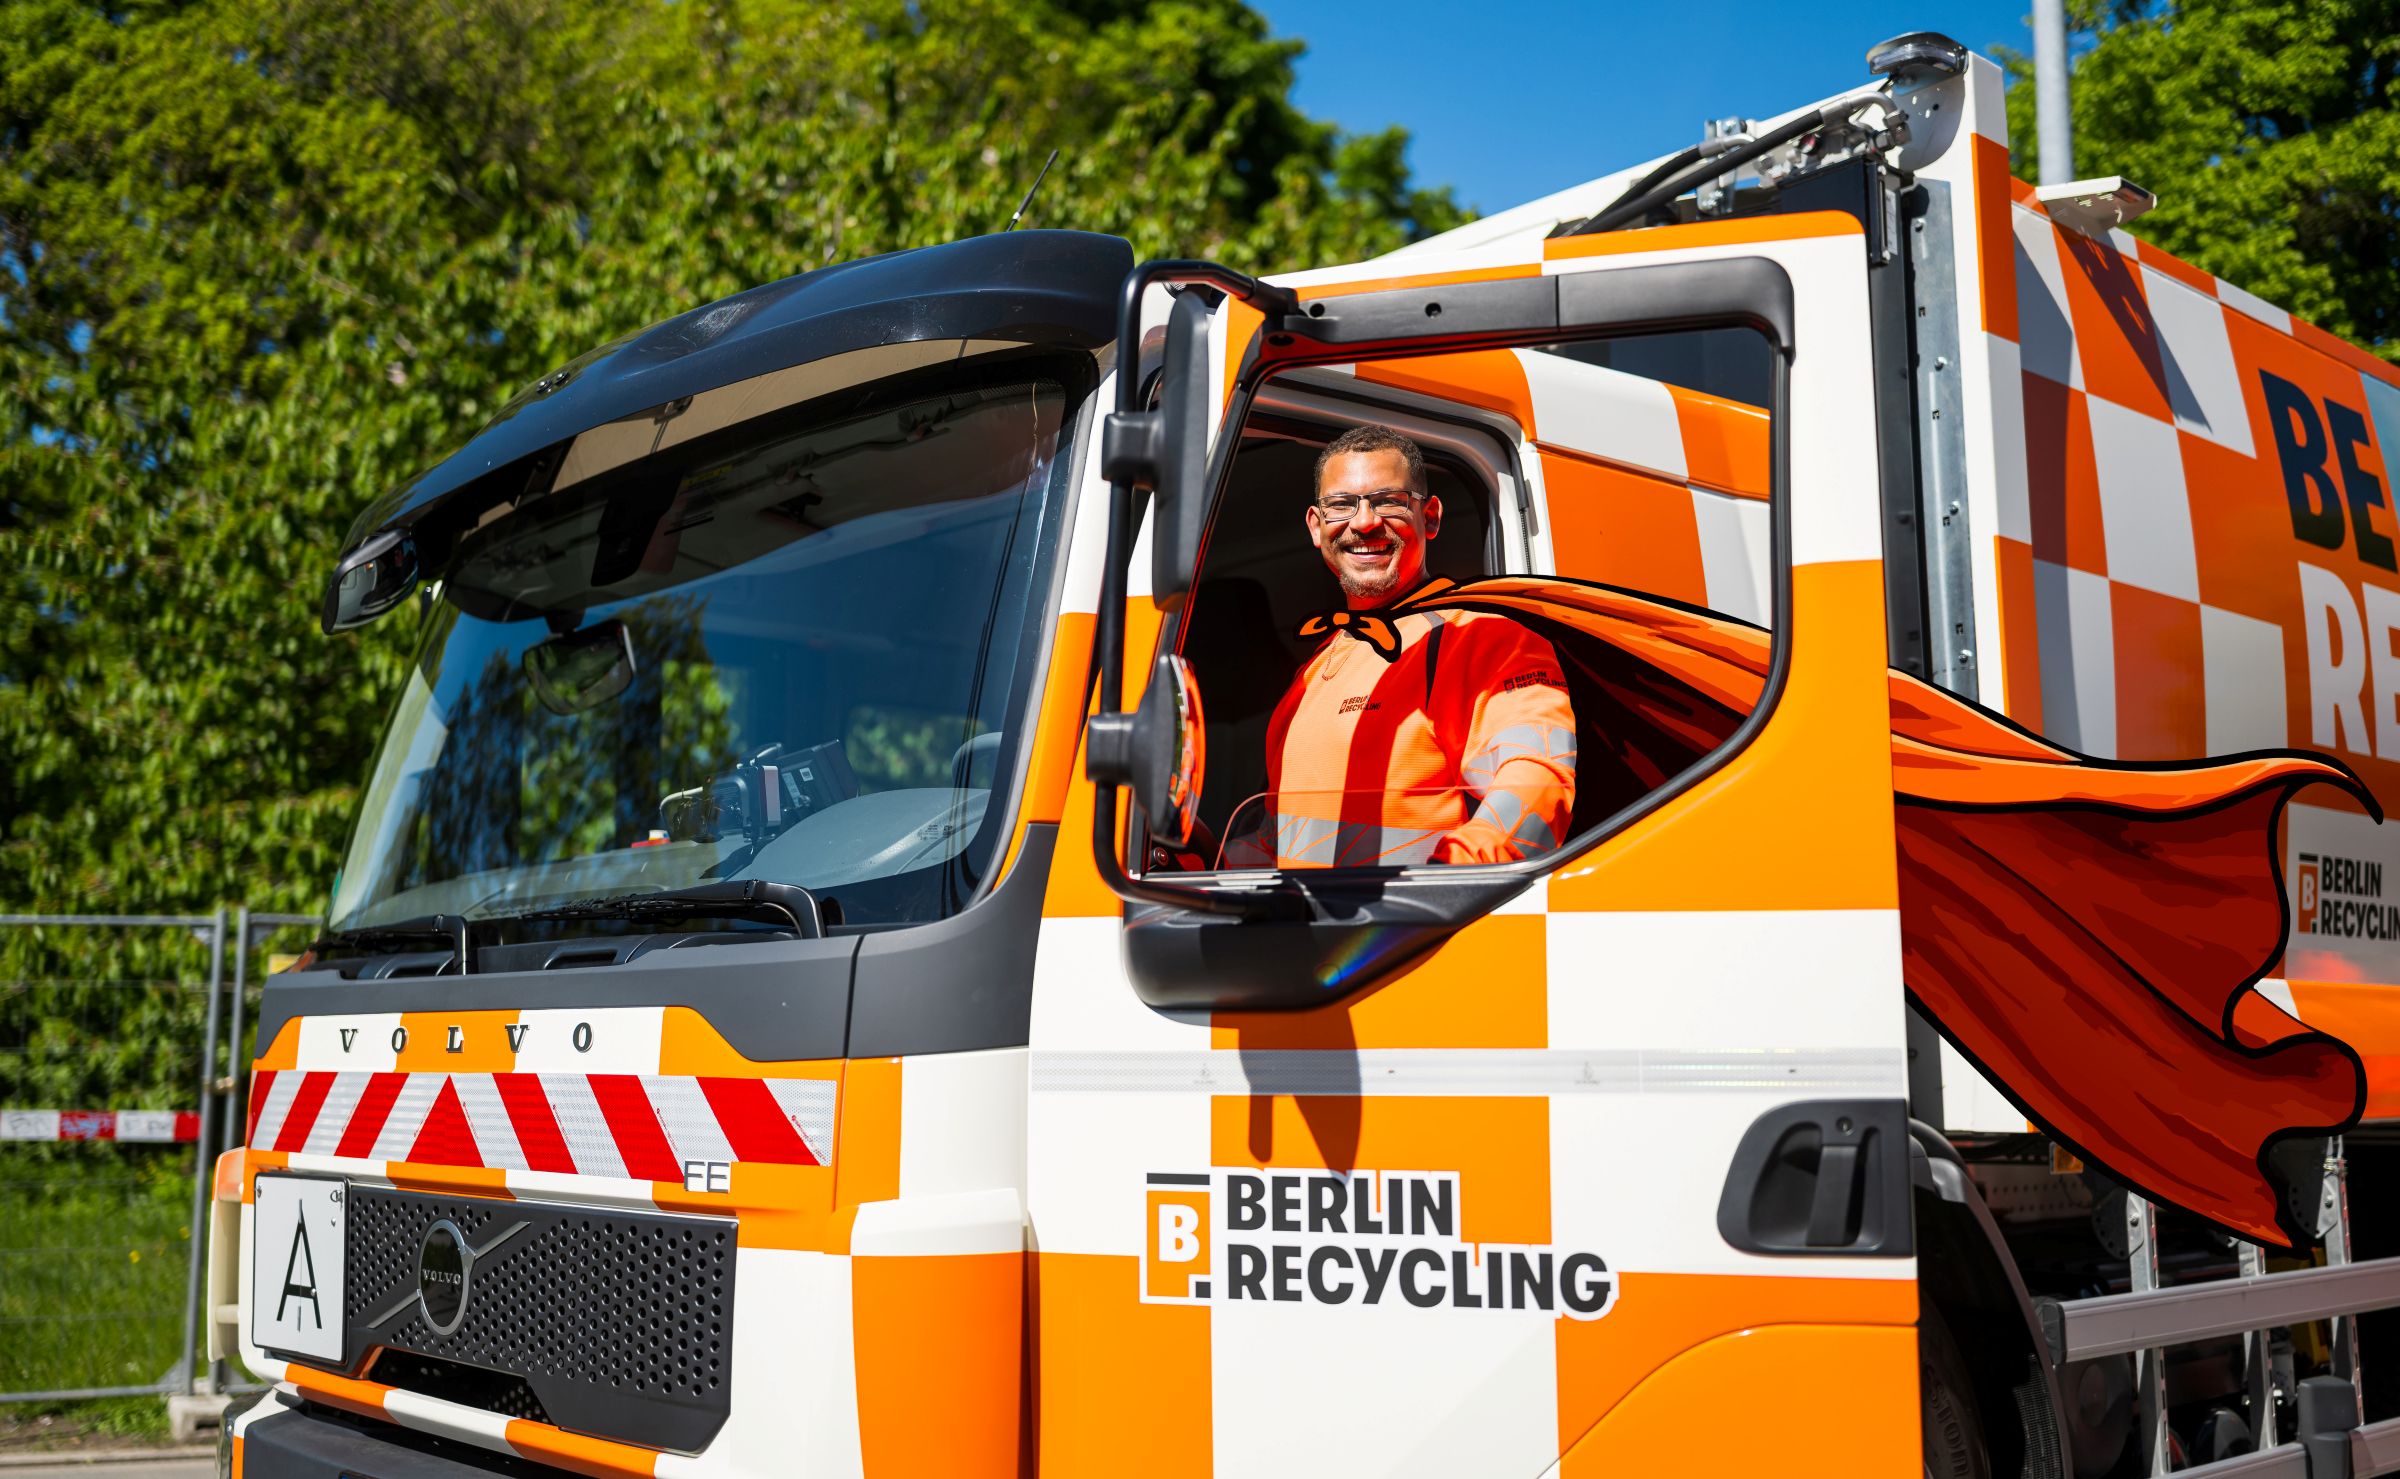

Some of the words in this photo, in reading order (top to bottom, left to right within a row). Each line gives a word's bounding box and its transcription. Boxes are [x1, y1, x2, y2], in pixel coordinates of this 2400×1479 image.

[2321, 856, 2382, 898] BERLIN
[340, 1022, 594, 1054] VOLVO
[684, 1160, 730, 1193] FE
[1227, 1174, 1454, 1236] BERLIN
[276, 1199, 323, 1330] A
[421, 1268, 462, 1286] VOLVO
[1227, 1243, 1611, 1313] RECYCLING
